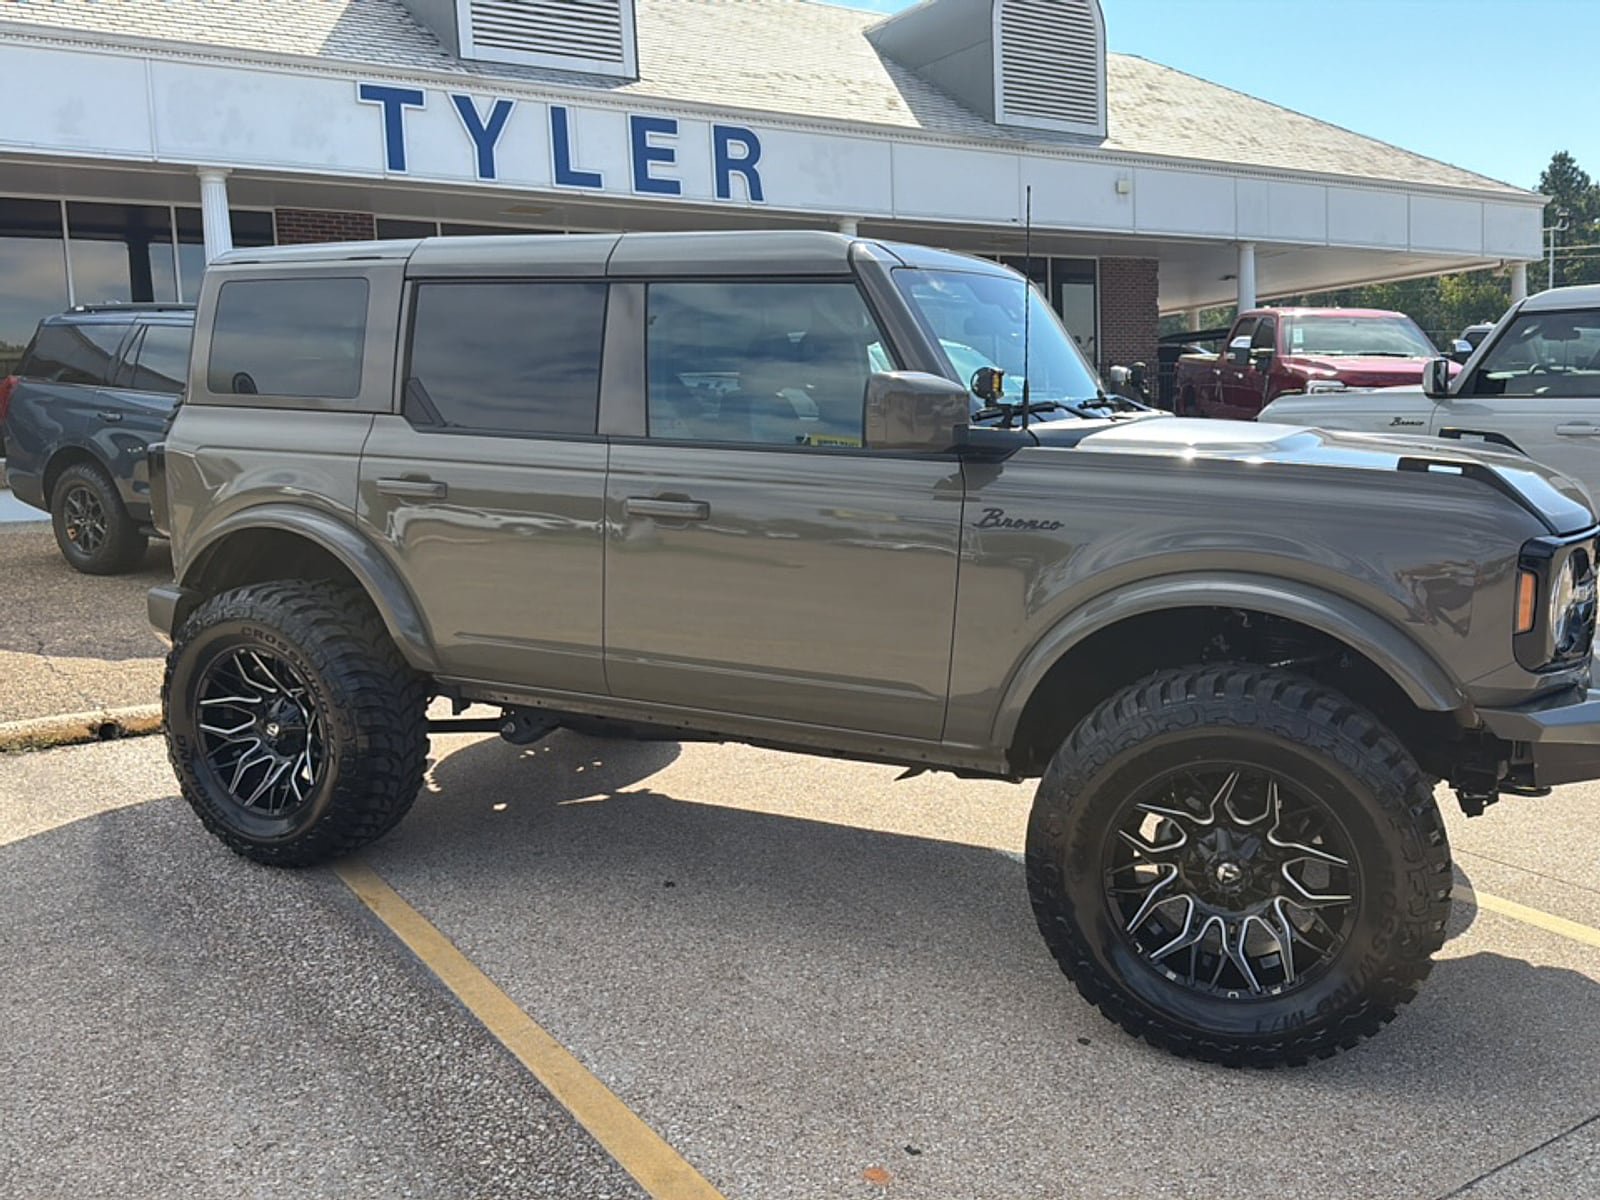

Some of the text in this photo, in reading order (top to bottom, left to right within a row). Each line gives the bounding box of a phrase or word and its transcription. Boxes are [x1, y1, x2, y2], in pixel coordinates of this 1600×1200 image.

[358, 83, 765, 203] TYLER
[1389, 416, 1425, 427] Bronco
[973, 507, 1065, 531] Bronco
